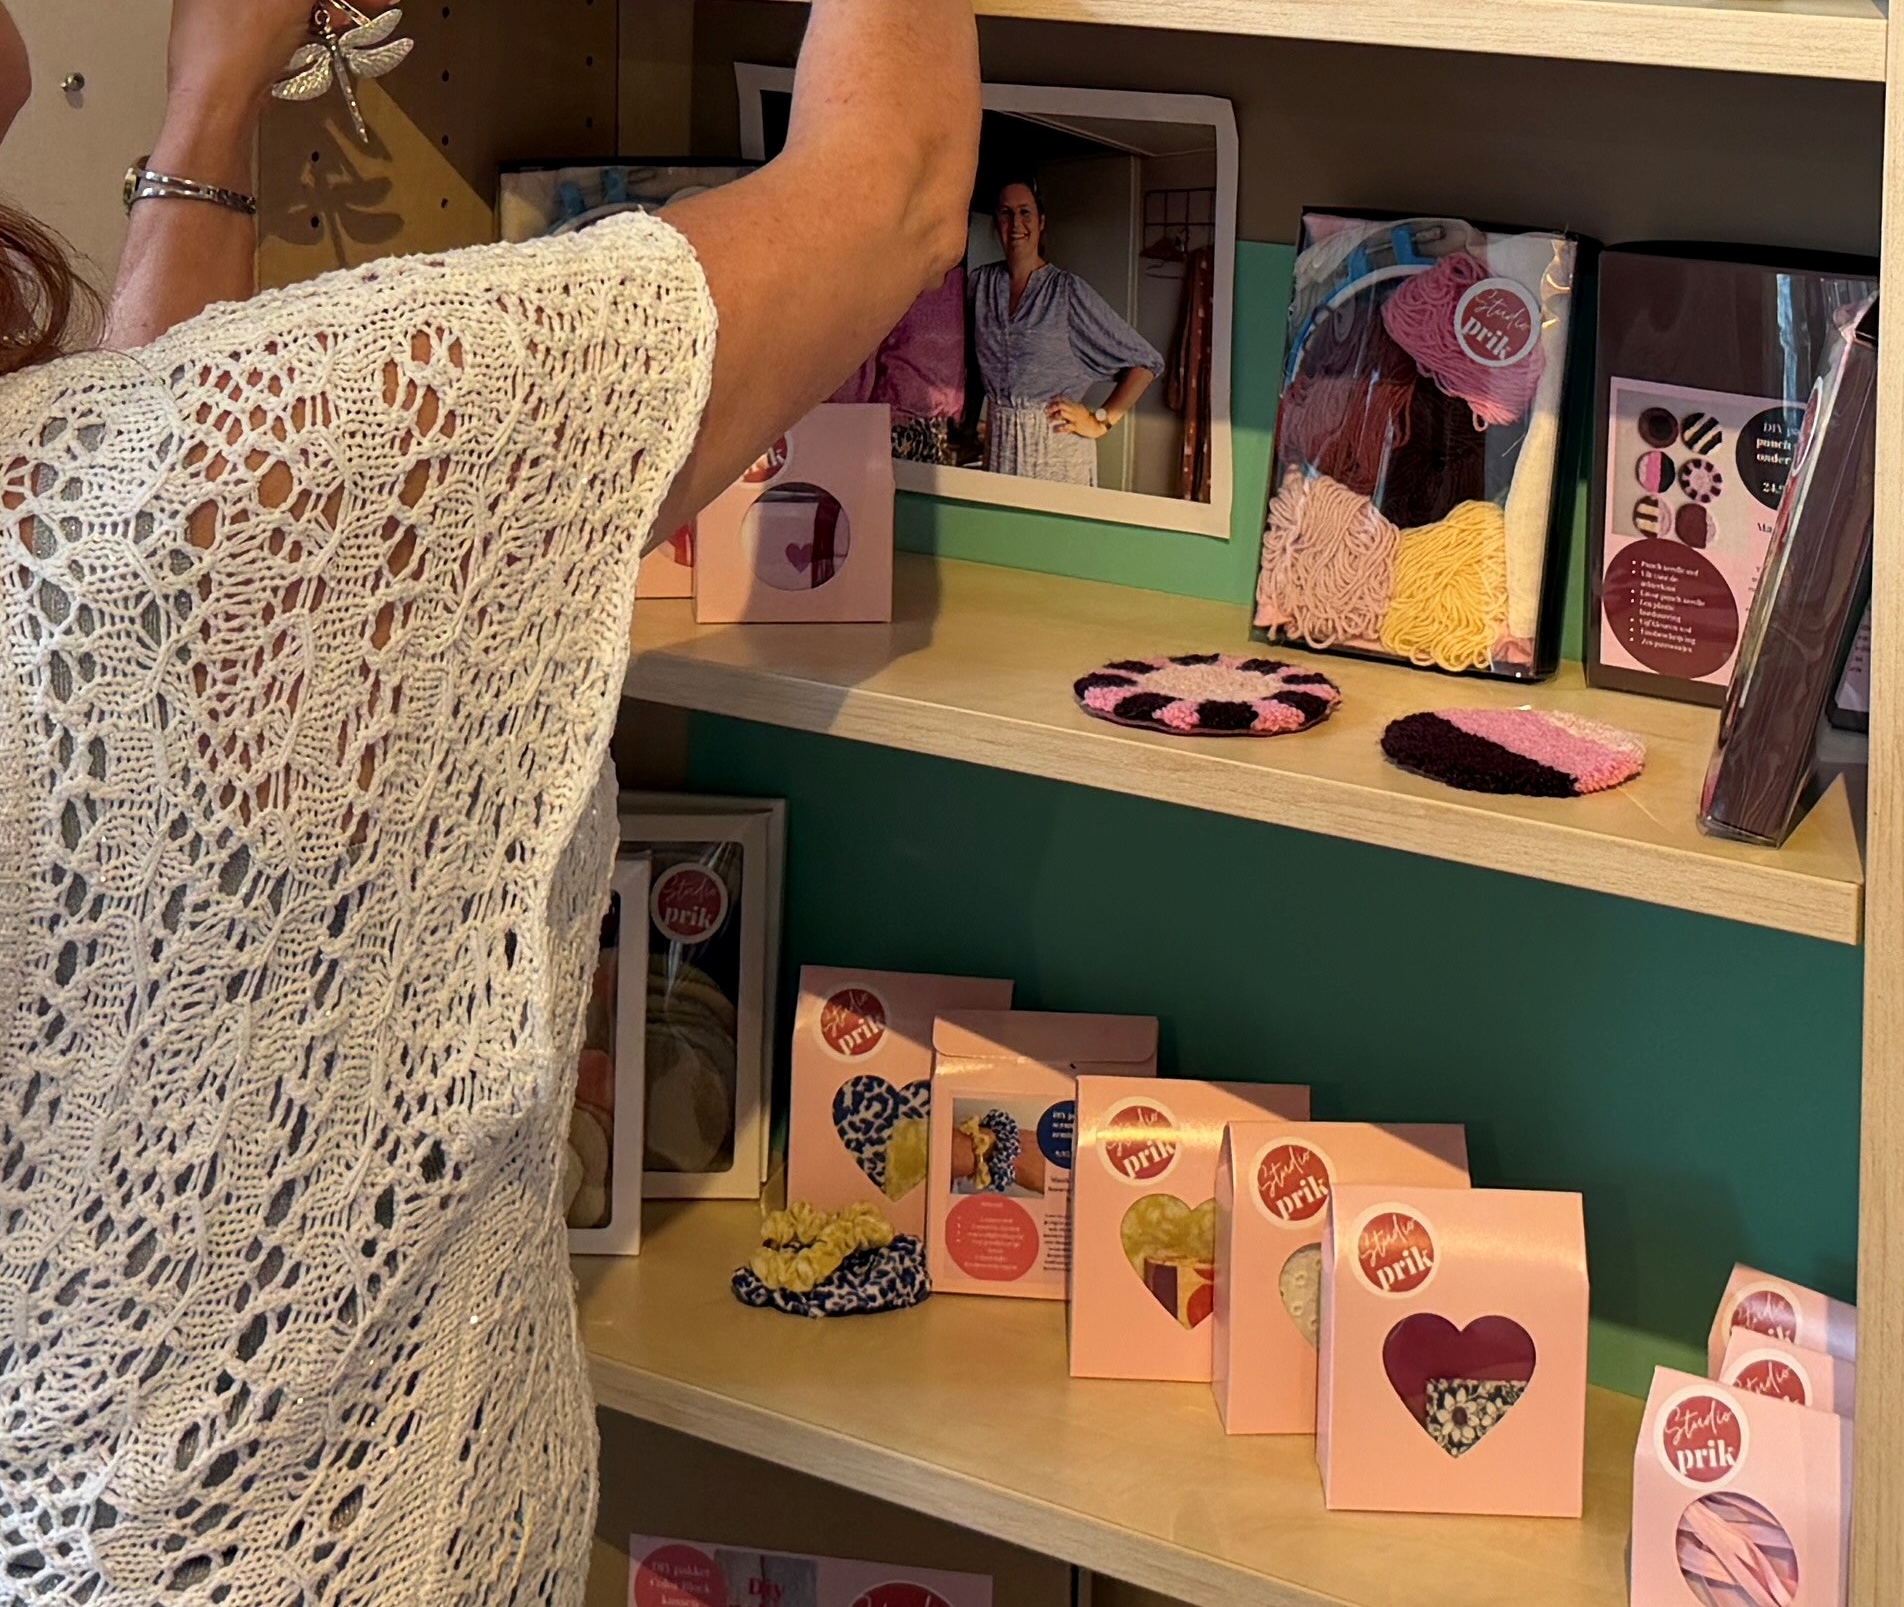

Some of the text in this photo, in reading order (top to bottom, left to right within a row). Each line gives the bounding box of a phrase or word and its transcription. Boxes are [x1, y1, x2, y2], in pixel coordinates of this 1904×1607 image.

[1462, 316, 1512, 360] prik
[663, 904, 714, 930] prik
[1376, 1246, 1433, 1293] prik
[1676, 1443, 1735, 1473] prik
